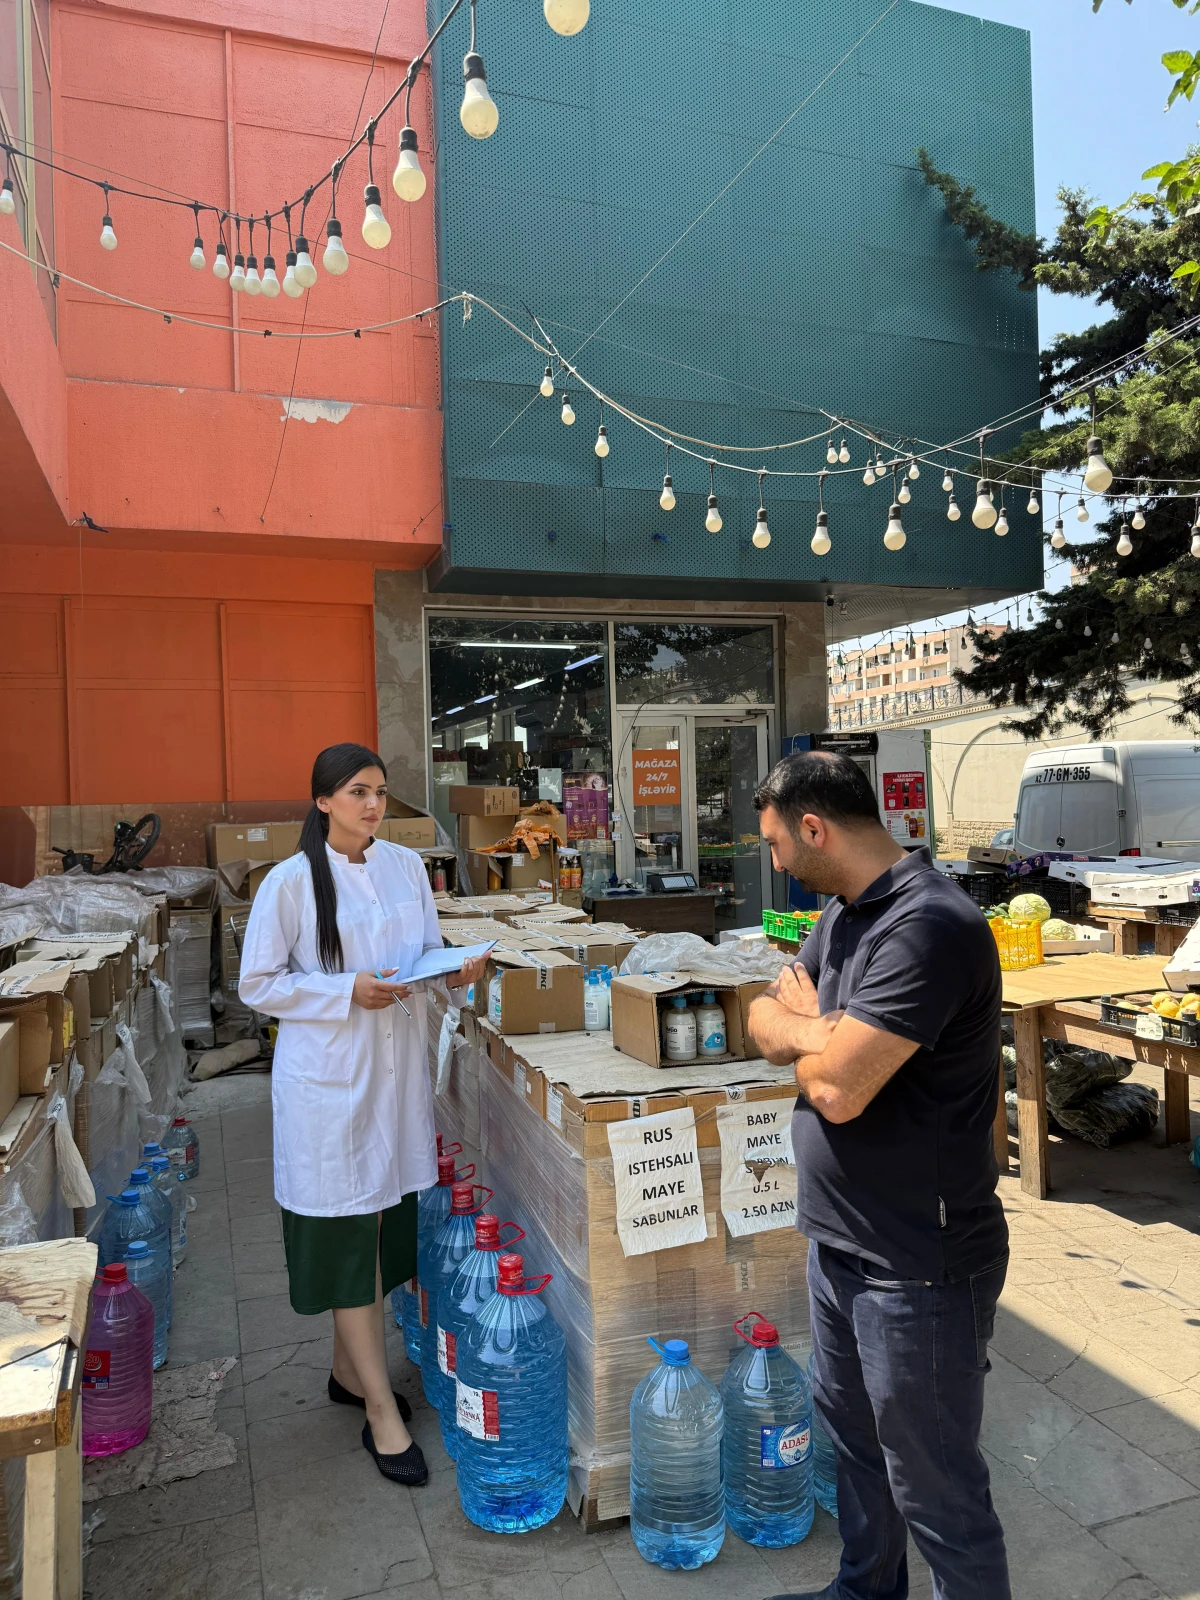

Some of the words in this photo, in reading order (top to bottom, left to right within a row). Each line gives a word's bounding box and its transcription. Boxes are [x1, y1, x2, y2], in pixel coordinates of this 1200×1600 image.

[635, 758, 678, 769] MAĞAZA
[645, 772, 669, 782] 24/7
[1034, 774, 1042, 783] AZ
[638, 783, 677, 796] İŞLƏYİR
[746, 1112, 778, 1127] BABY
[643, 1127, 673, 1145] RUS
[746, 1133, 782, 1149] MAYE
[628, 1151, 694, 1176] ISTEHSALI
[642, 1180, 686, 1201] MAYE
[774, 1180, 780, 1190] L
[632, 1204, 699, 1228] SABUNLAR
[741, 1204, 768, 1219] 2.50
[770, 1200, 795, 1215] AZN
